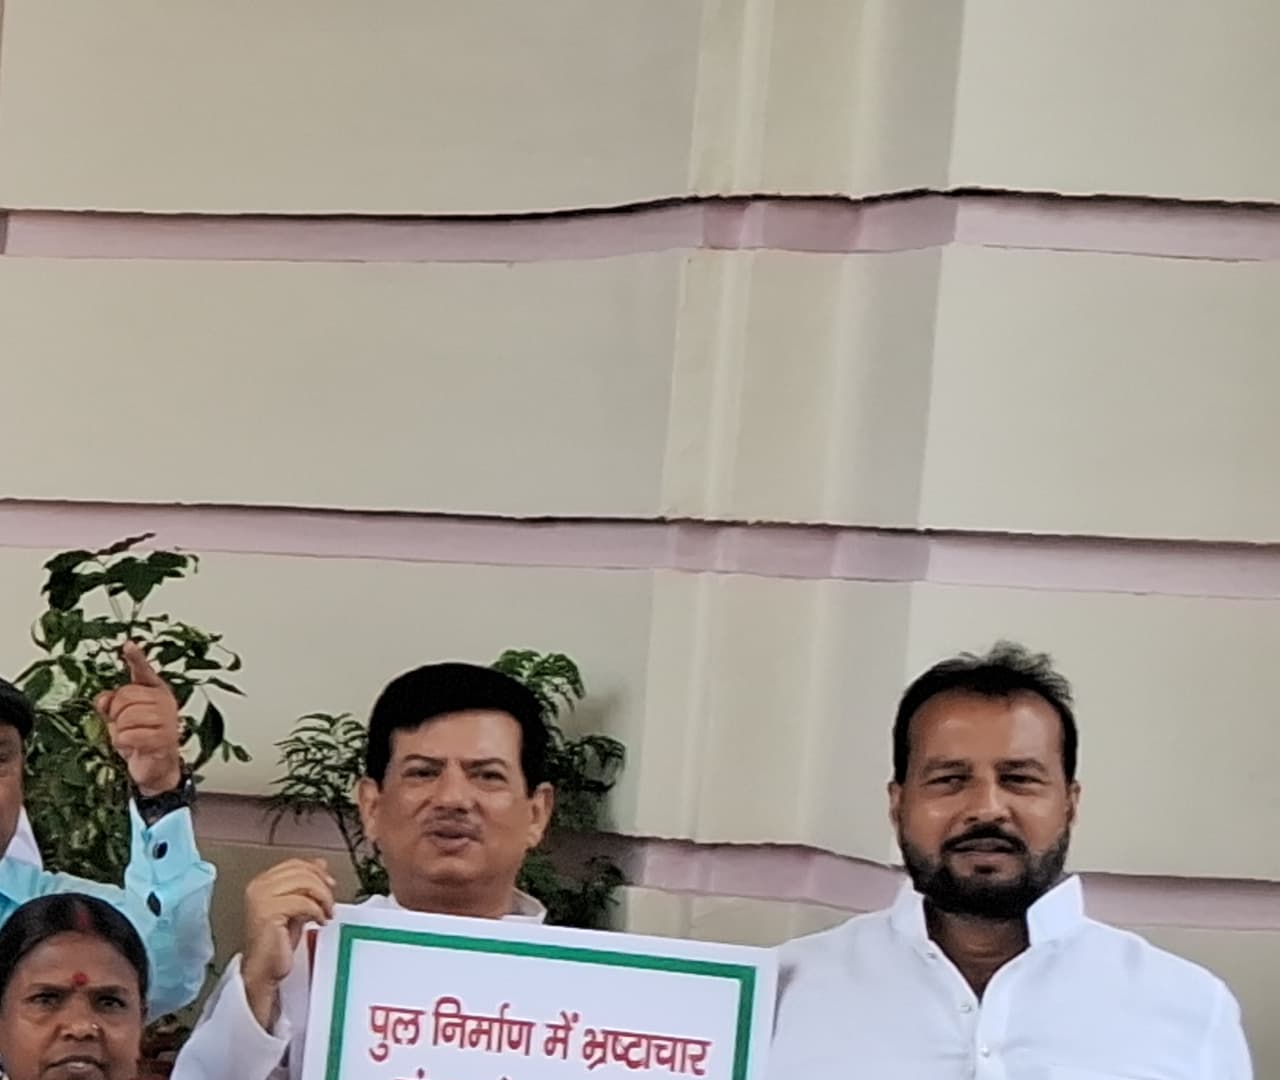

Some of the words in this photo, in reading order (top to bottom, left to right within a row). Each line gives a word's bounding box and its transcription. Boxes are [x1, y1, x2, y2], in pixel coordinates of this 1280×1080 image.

[369, 1005, 425, 1061] पुल
[433, 997, 535, 1056] निर्माण
[544, 1011, 580, 1059] में
[583, 1028, 711, 1076] भ्रष्टाचार
